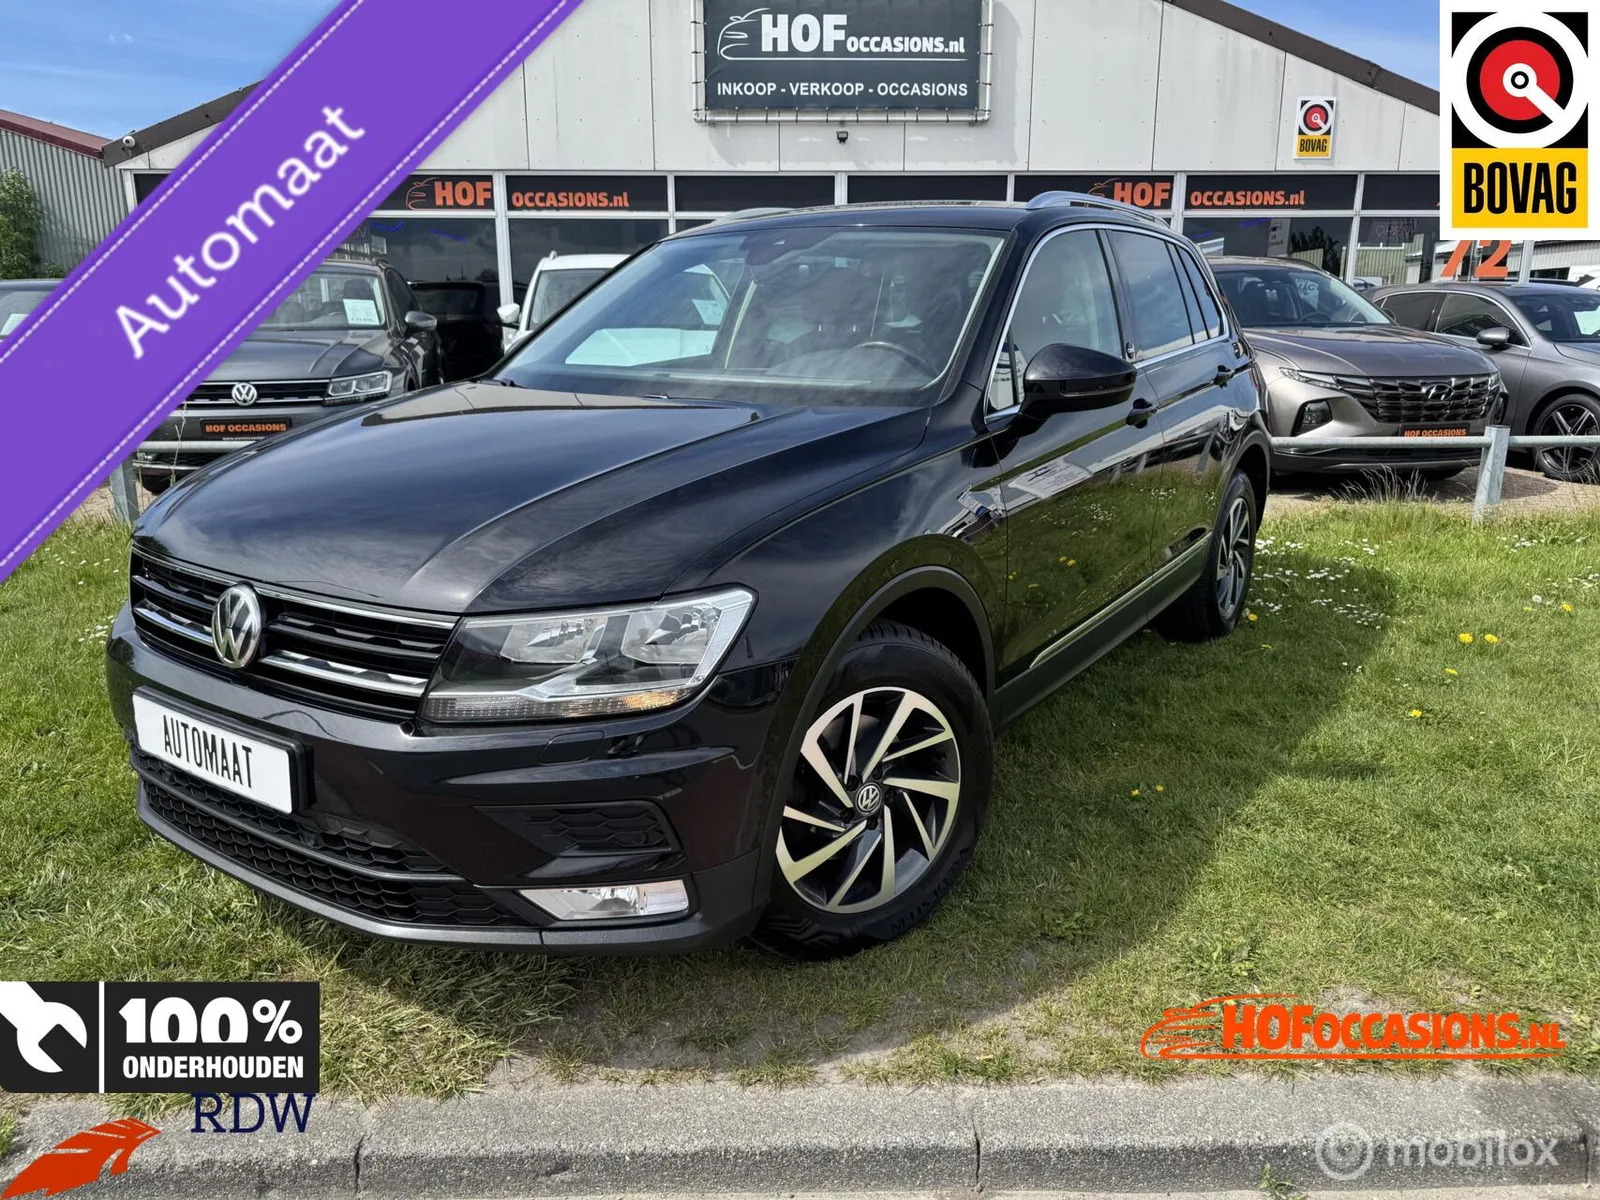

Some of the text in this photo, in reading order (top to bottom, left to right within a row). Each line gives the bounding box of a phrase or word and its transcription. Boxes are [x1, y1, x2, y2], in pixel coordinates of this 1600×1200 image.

[717, 83, 777, 95] INKOOP
[789, 83, 864, 95] VERKOOP
[877, 83, 968, 96] OCCASIONS
[1299, 138, 1328, 153] BOVAG
[433, 181, 629, 207] HOF OCCASIONS.nl
[1113, 182, 1306, 206] HOF OCCASIONS.nl
[205, 423, 287, 433] HOF OCCASIONS
[163, 714, 253, 789] AUTOMAAT
